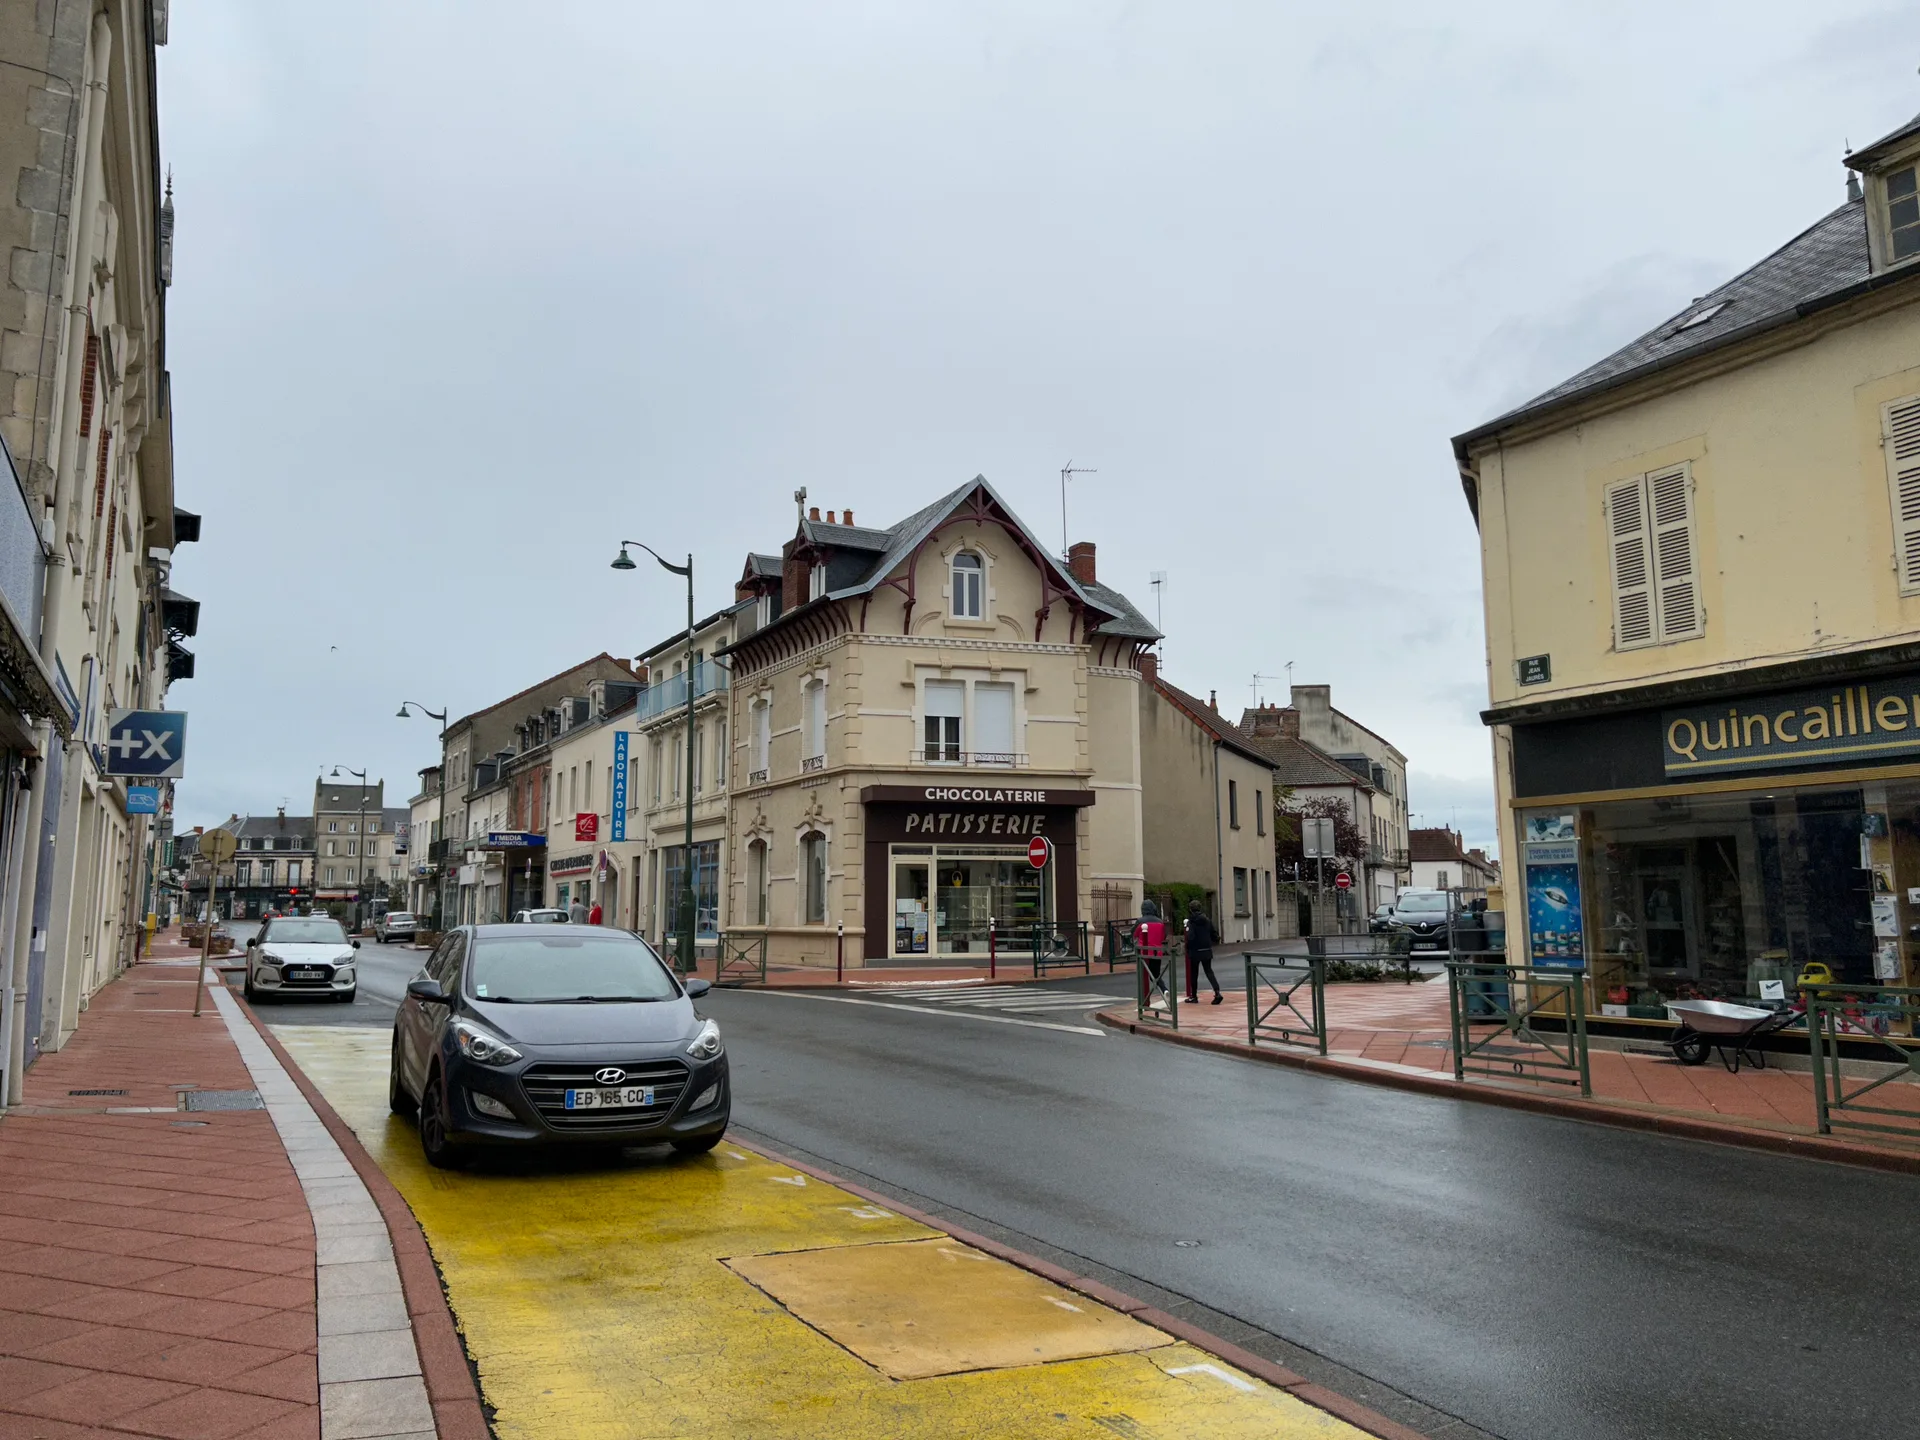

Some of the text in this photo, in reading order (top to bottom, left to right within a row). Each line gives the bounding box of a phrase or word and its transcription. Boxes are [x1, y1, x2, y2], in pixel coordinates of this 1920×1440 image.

[615, 733, 625, 838] LABORATOIRE
[925, 788, 1046, 802] CHOCOLATERIE
[905, 813, 1046, 834] PATISSERIE
